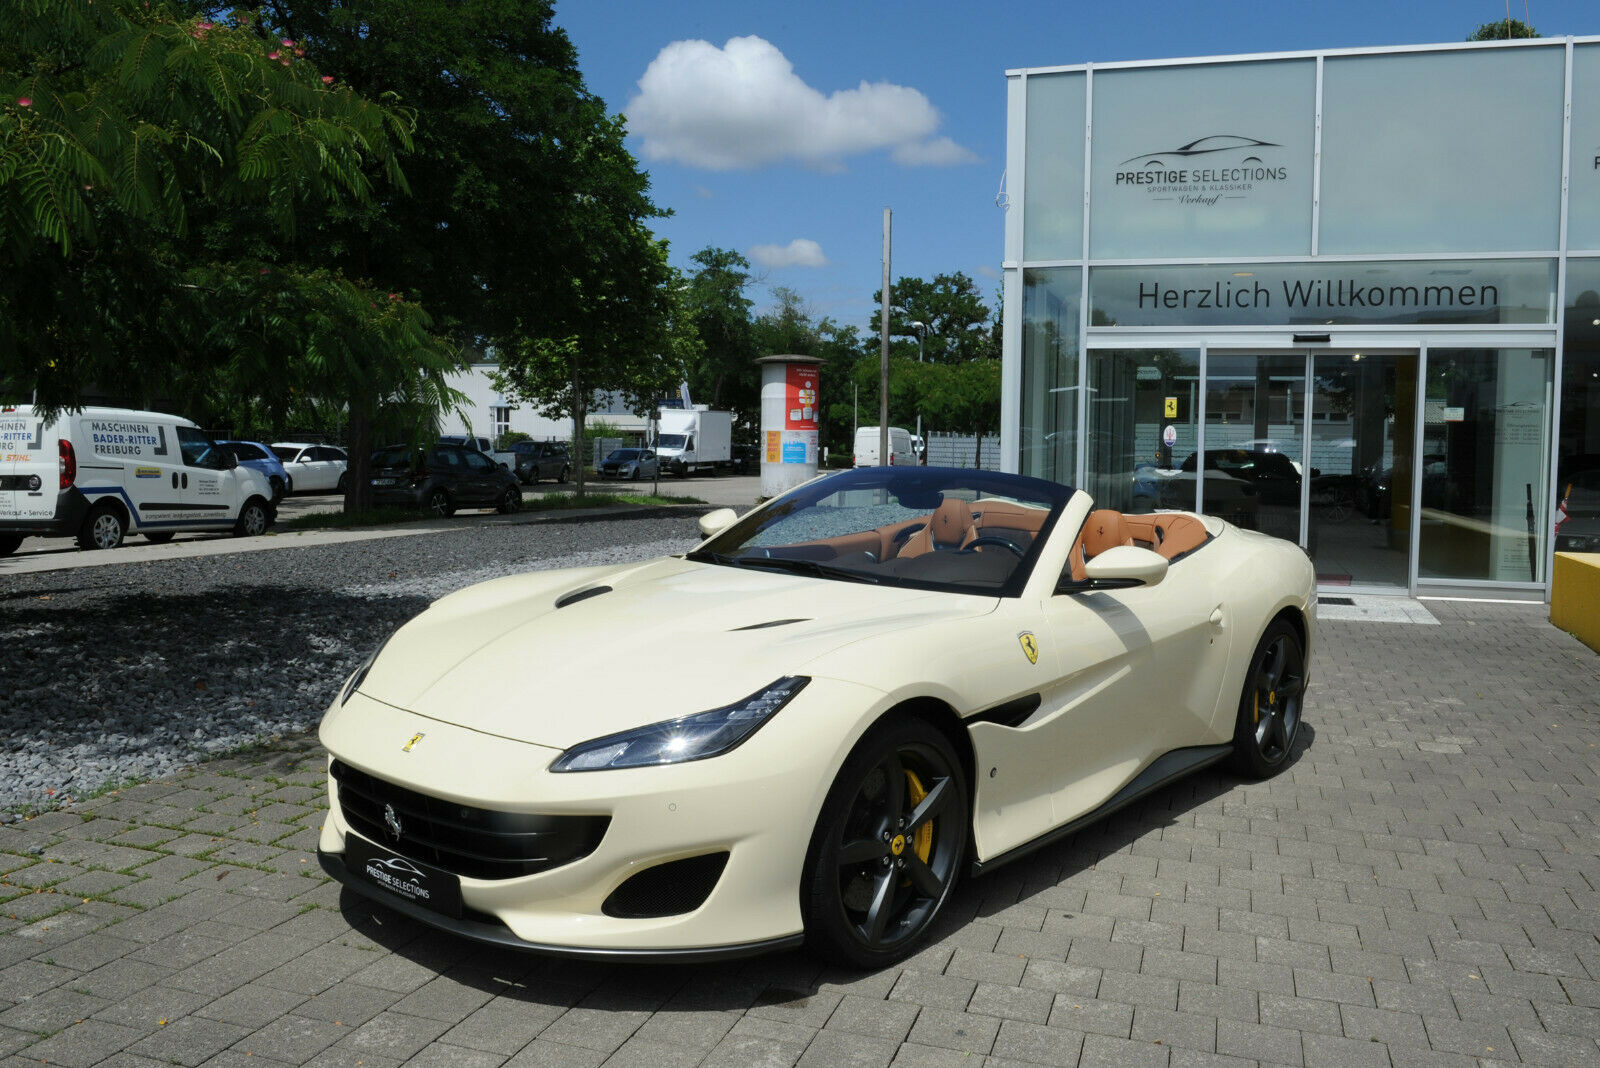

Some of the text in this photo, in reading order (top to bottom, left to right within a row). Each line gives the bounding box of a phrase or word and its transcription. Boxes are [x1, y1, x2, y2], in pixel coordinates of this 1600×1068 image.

[1115, 167, 1287, 185] PRESTIGE SELECTIONS
[1147, 185, 1200, 193] SPORTWAGEN
[1178, 193, 1223, 206] Verkauf
[1139, 279, 1499, 308] Herzlich Willkommen
[92, 422, 149, 433] MASCHINEN
[93, 433, 157, 445] BADER-RITTER
[95, 444, 141, 455] FREIBURG
[6, 454, 31, 462] STIHL
[366, 864, 392, 884] PRESTIGE
[392, 877, 430, 899] SELECTIONS
